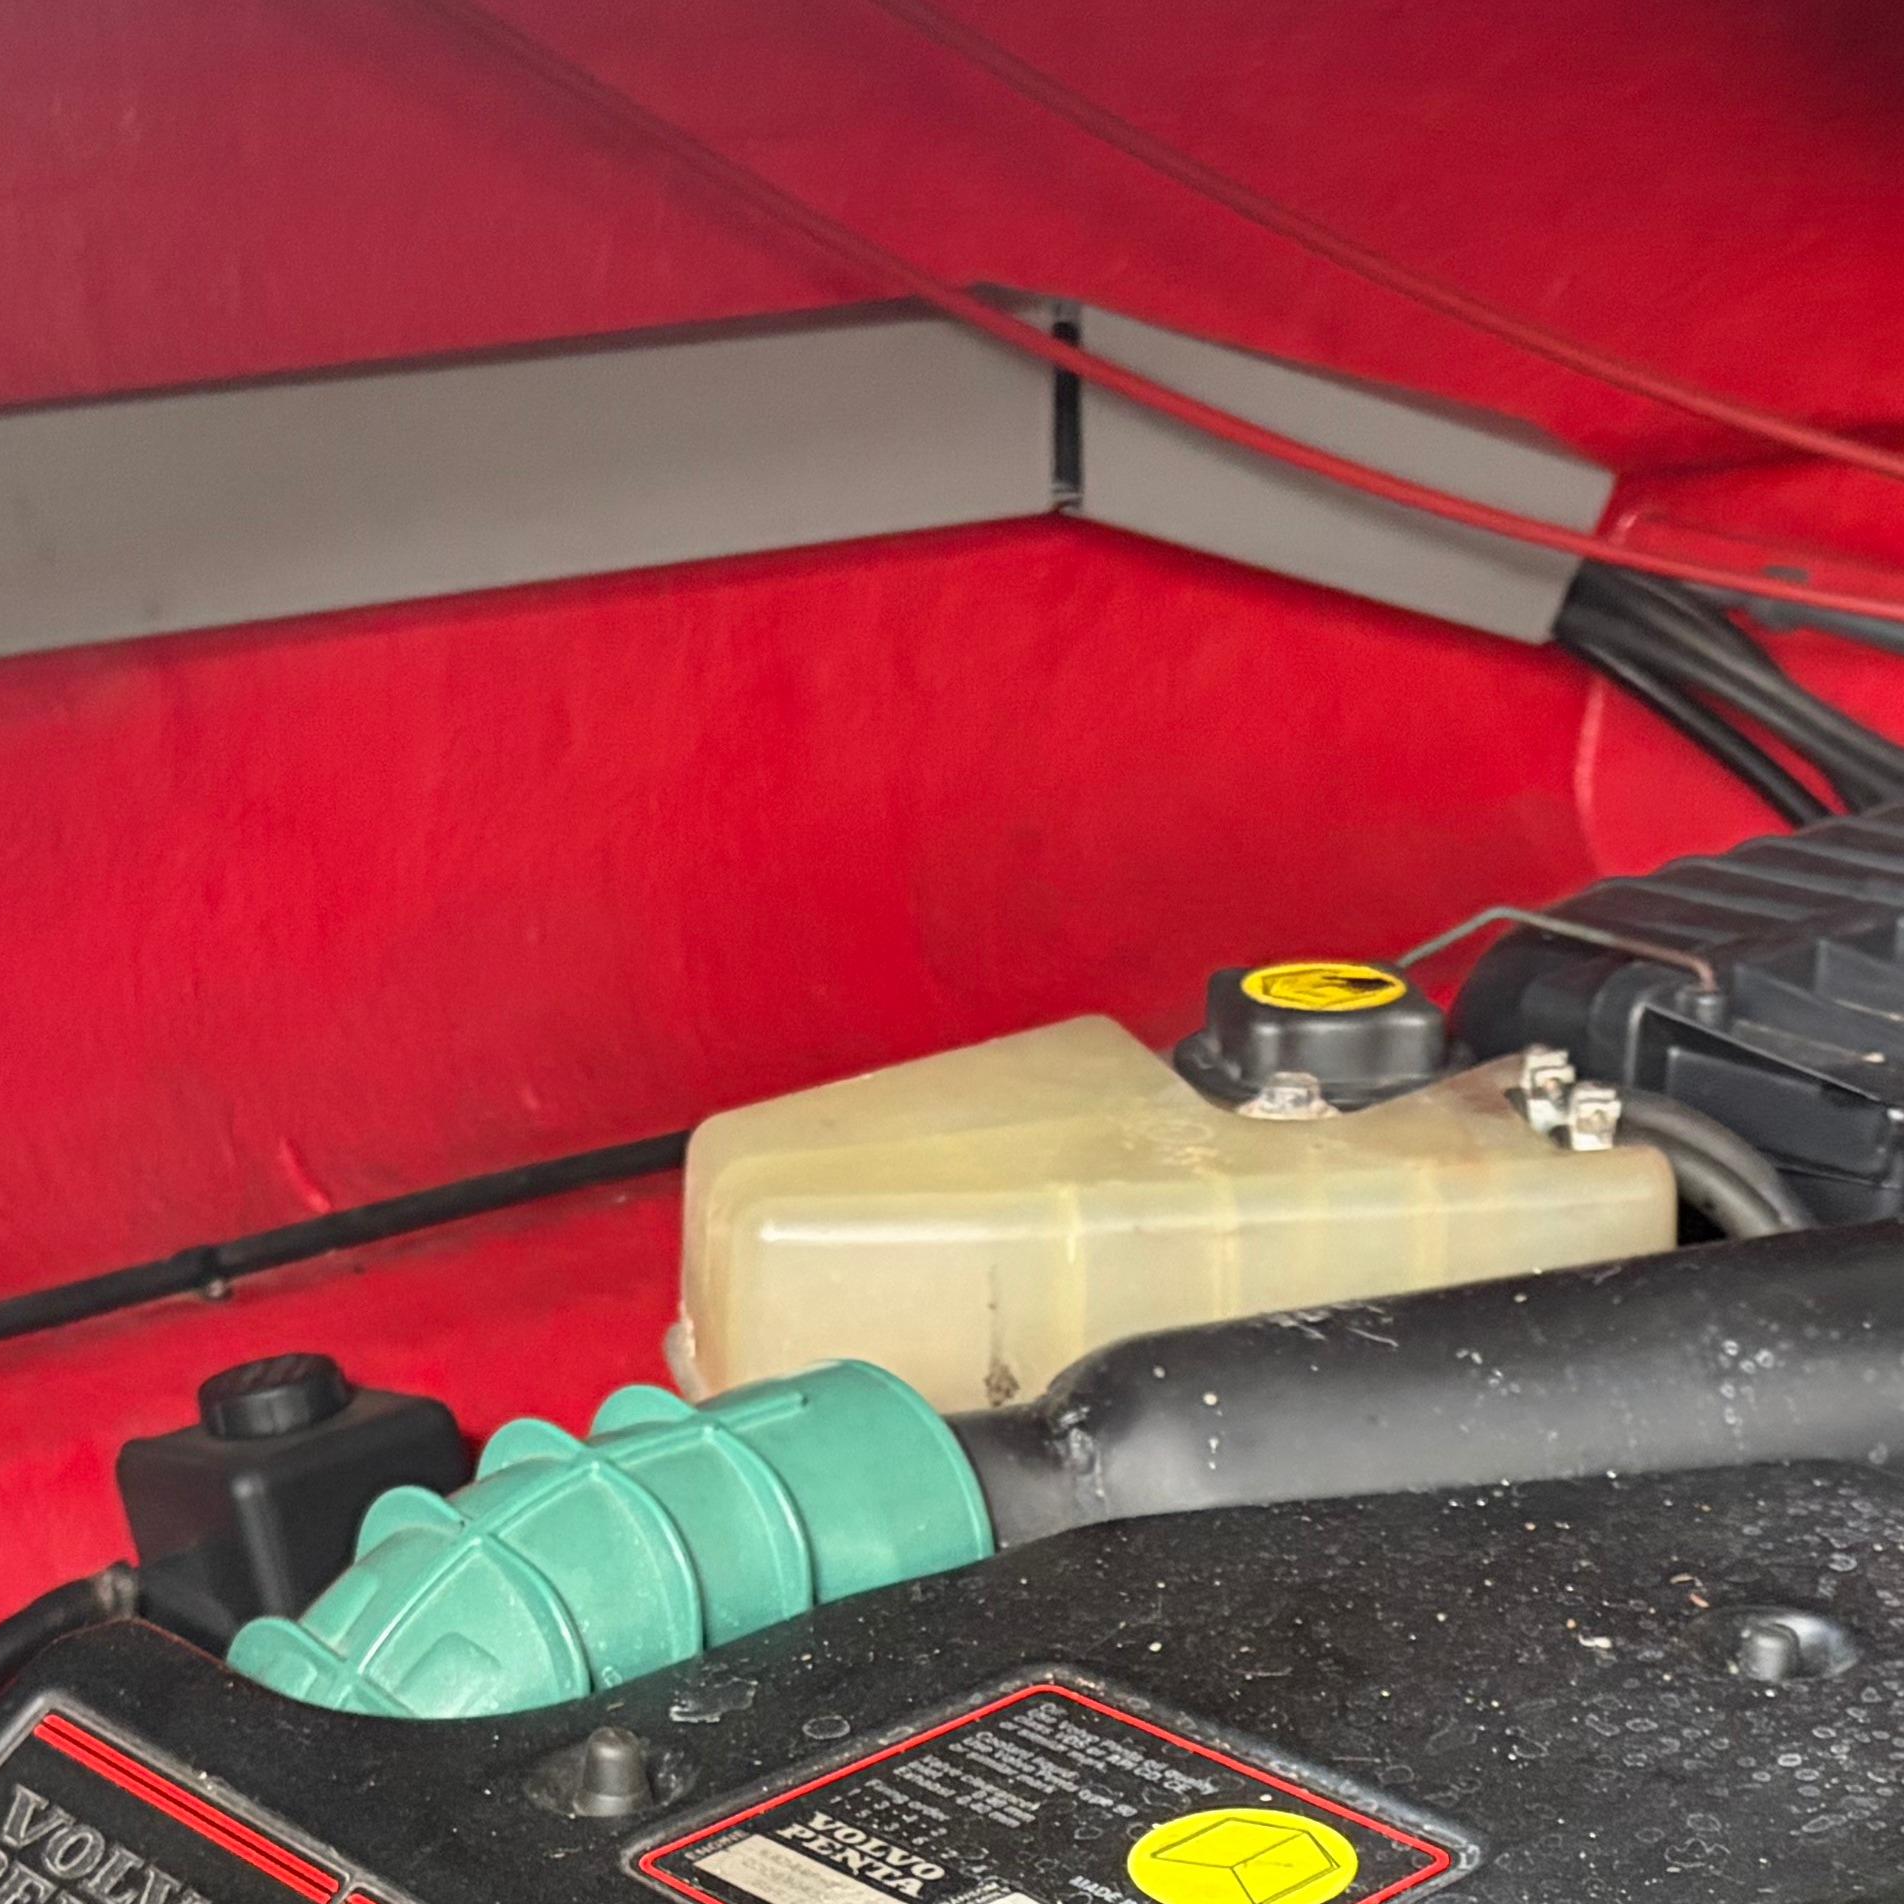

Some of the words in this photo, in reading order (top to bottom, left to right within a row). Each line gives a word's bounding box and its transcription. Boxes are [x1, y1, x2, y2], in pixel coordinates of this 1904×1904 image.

[777, 1823, 922, 1897] PENTA
[808, 1811, 944, 1880] VOLVO
[1069, 1875, 1122, 1902] MADE
